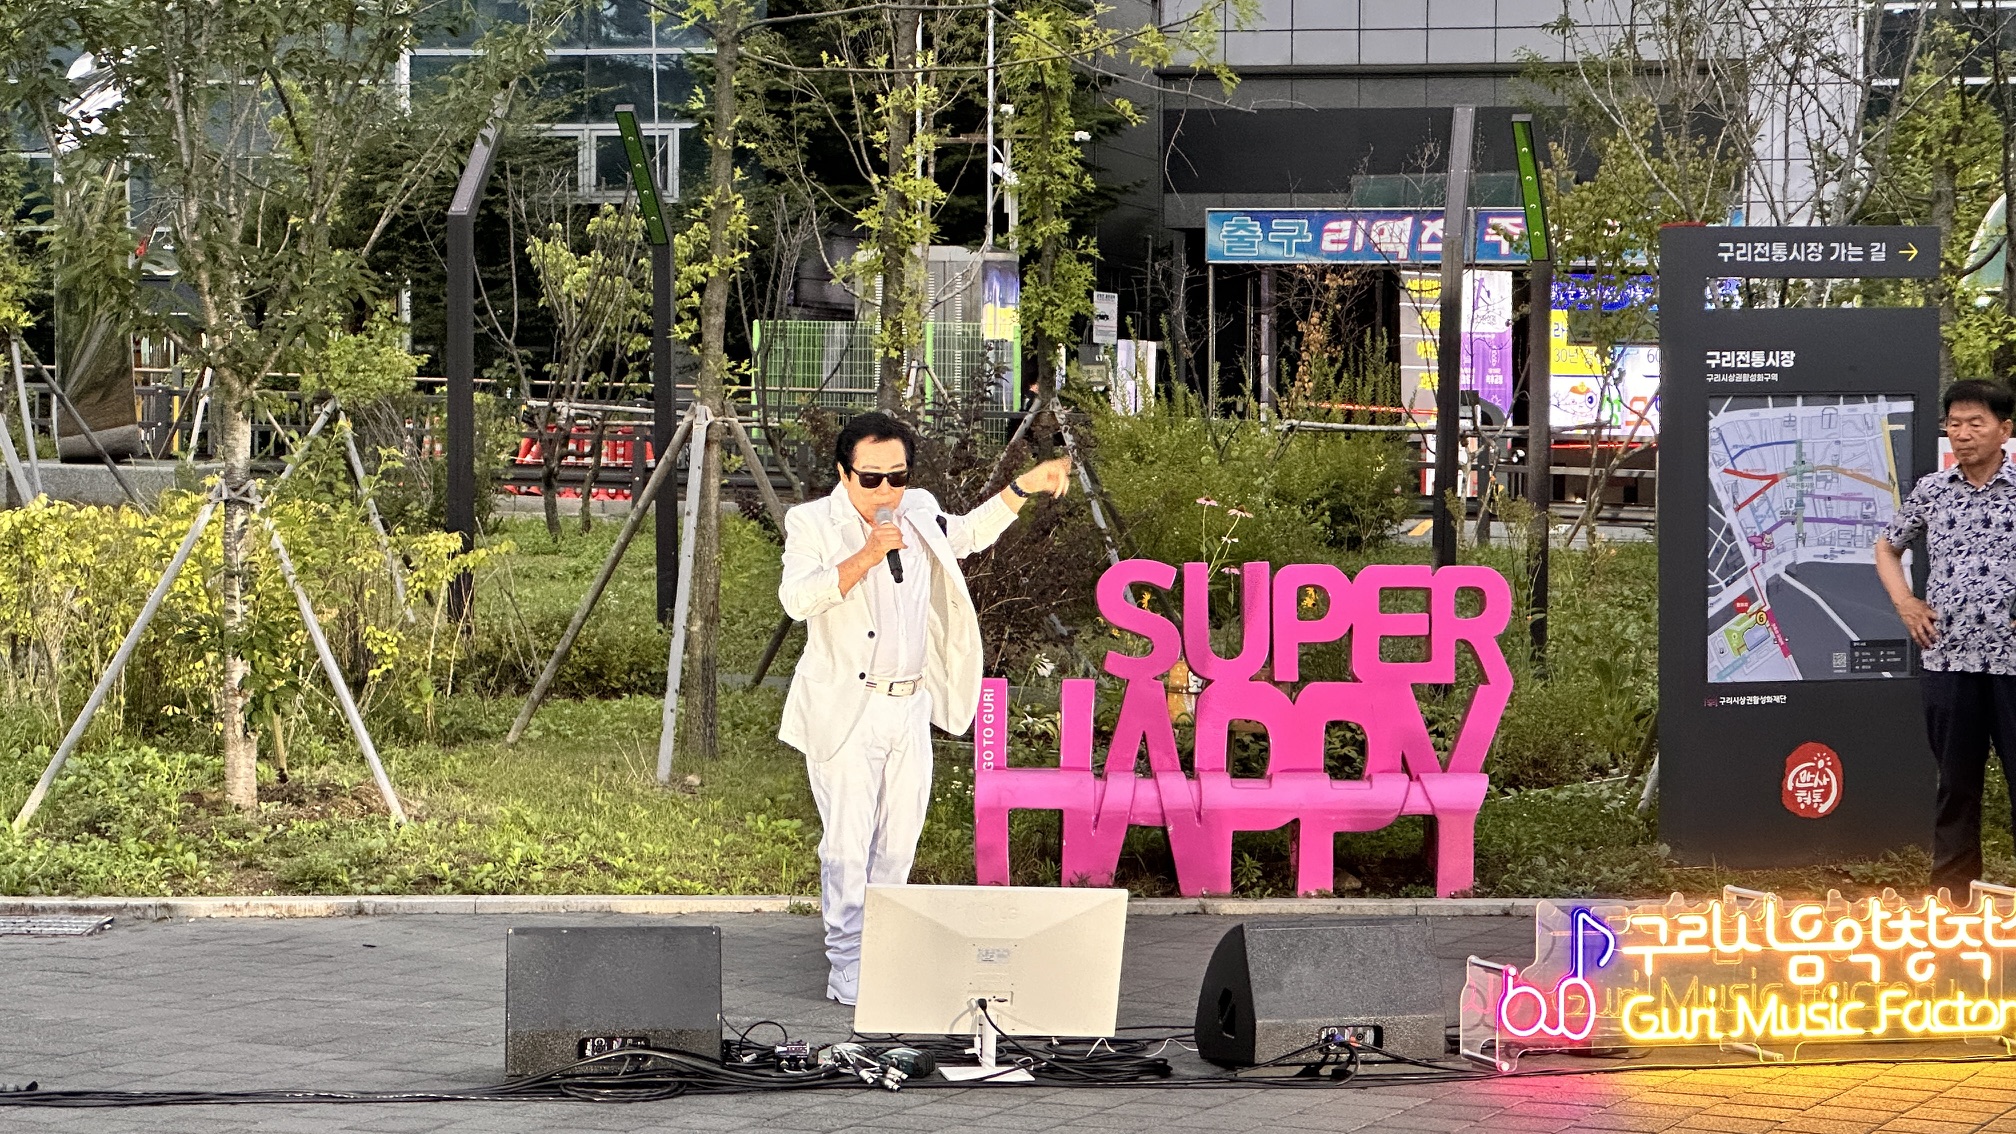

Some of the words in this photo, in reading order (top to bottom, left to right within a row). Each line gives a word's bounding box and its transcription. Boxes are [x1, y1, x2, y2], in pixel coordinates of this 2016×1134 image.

[1219, 216, 1313, 258] 출구
[1717, 242, 1824, 263] 구리전통시장
[1829, 242, 1864, 262] 가는
[1870, 242, 1887, 262] 길
[1705, 350, 1796, 369] 구리전통시장
[1706, 372, 1779, 383] 구리시상권활성화구역
[1095, 559, 1514, 683] SUPER
[1758, 612, 1765, 624] 6
[982, 688, 995, 724] GURI
[1719, 694, 1787, 706] 구리시상권활성화재단
[982, 727, 995, 748] TO
[982, 750, 995, 771] GO
[975, 677, 1514, 897] HAPPY
[1622, 987, 1724, 1040] Guri
[1730, 984, 1868, 1038] Music
